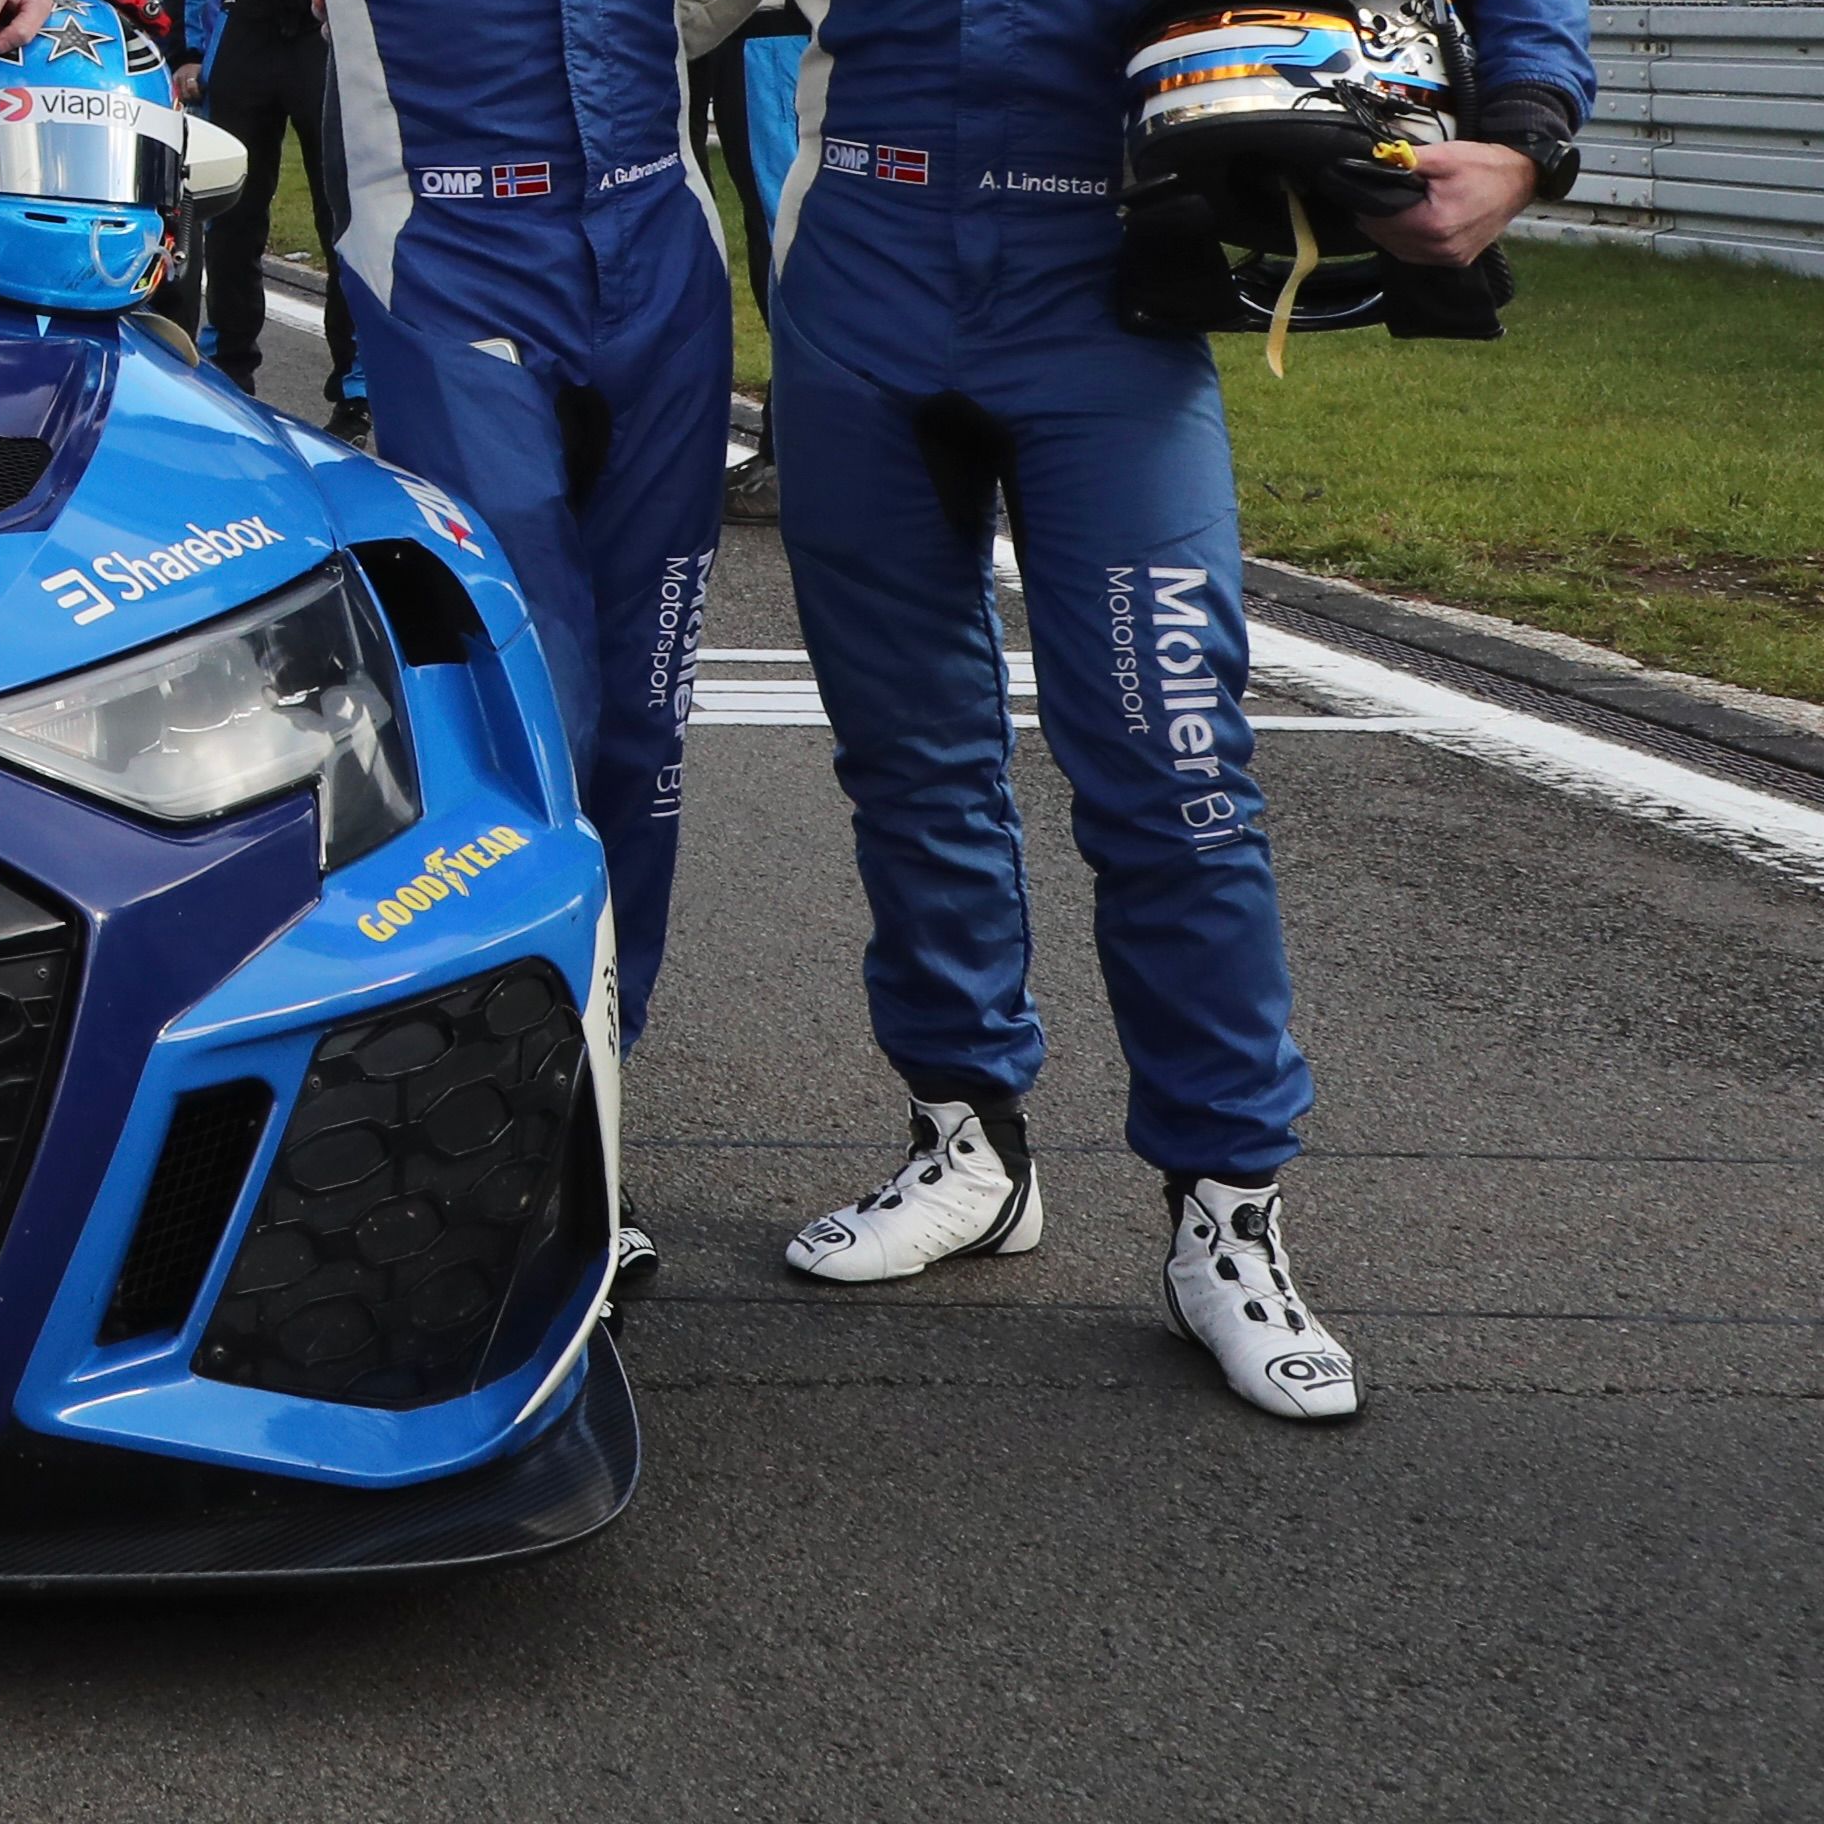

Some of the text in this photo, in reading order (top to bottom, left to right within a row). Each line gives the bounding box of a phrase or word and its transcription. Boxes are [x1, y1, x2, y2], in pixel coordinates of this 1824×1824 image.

[41, 89, 142, 127] viaplay
[824, 143, 870, 171] OMP
[421, 171, 483, 194] OMP
[598, 175, 614, 191] A.
[978, 170, 1108, 196] A. Lindstad
[99, 513, 286, 604] Sharebox
[646, 555, 689, 710] Motorsport
[1105, 566, 1152, 736] Motorsport
[650, 762, 684, 820] Bil
[1179, 790, 1246, 853] Bil
[357, 824, 530, 944] GOODYEAR
[798, 1218, 847, 1245] MP
